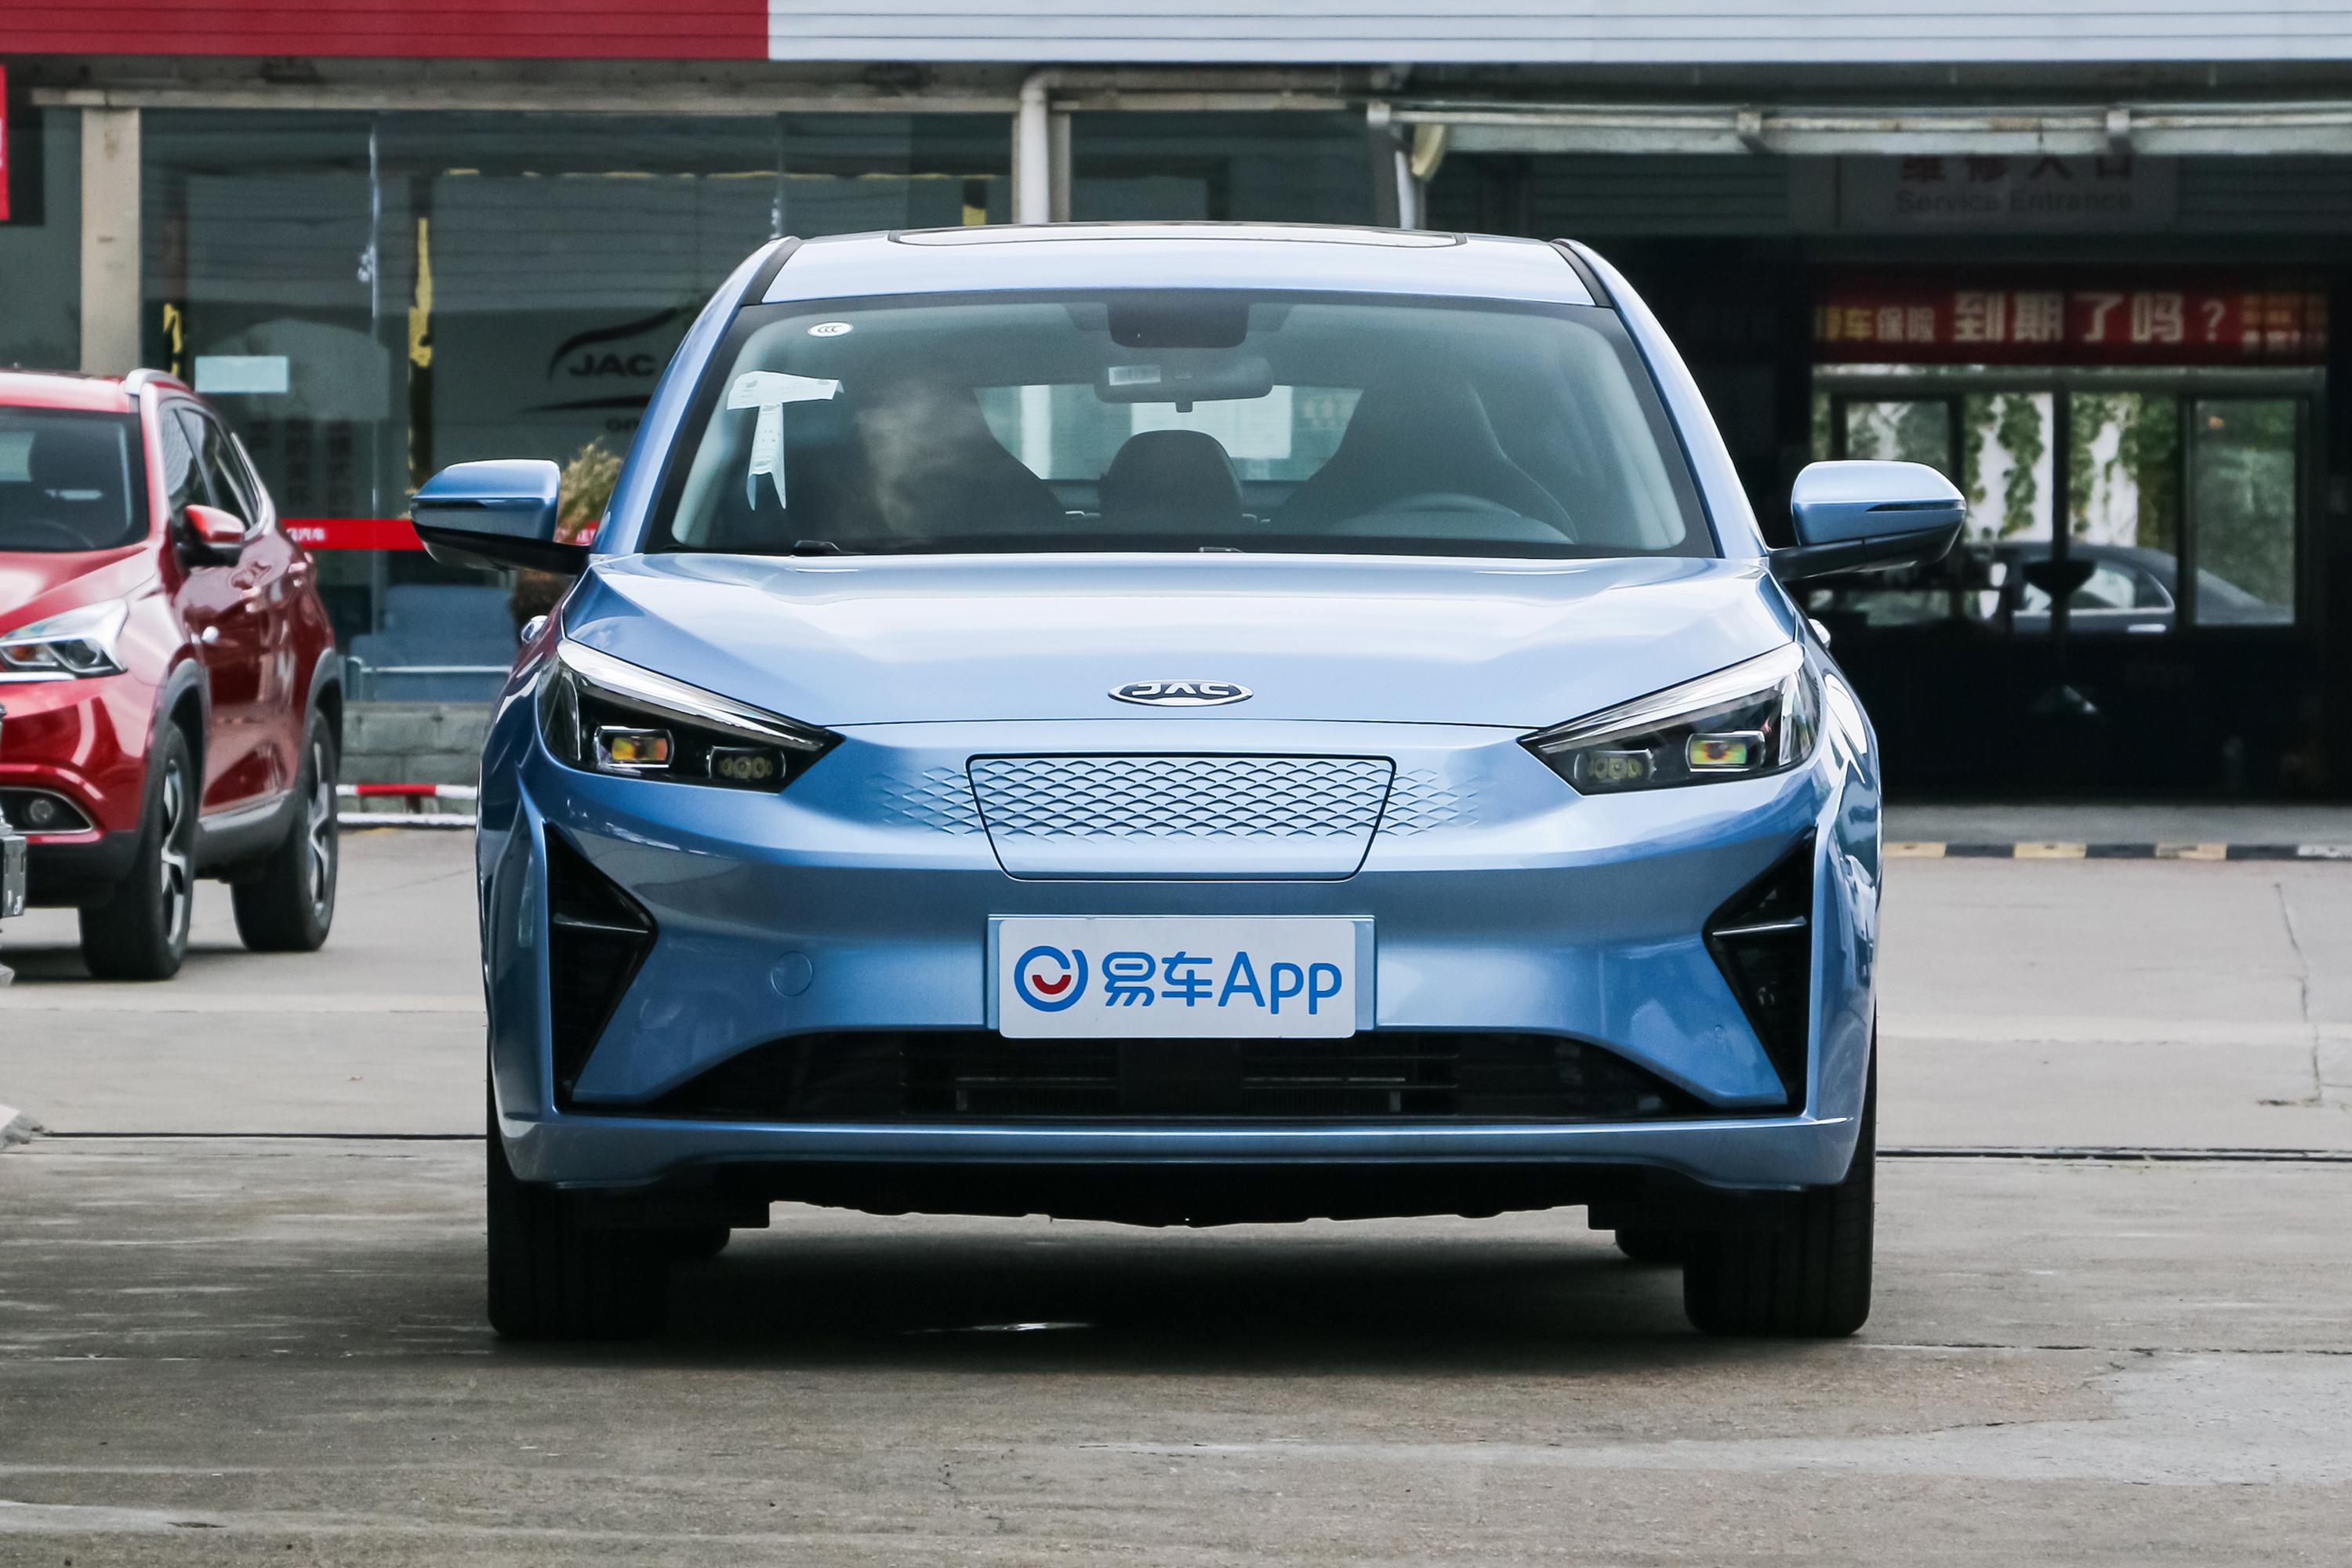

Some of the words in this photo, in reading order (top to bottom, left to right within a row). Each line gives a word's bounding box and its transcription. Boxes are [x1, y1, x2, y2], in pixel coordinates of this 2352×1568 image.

[1896, 189, 1999, 213] Service
[2010, 189, 2132, 212] Entrance
[568, 353, 656, 377] JAC
[1131, 682, 1230, 696] JAC
